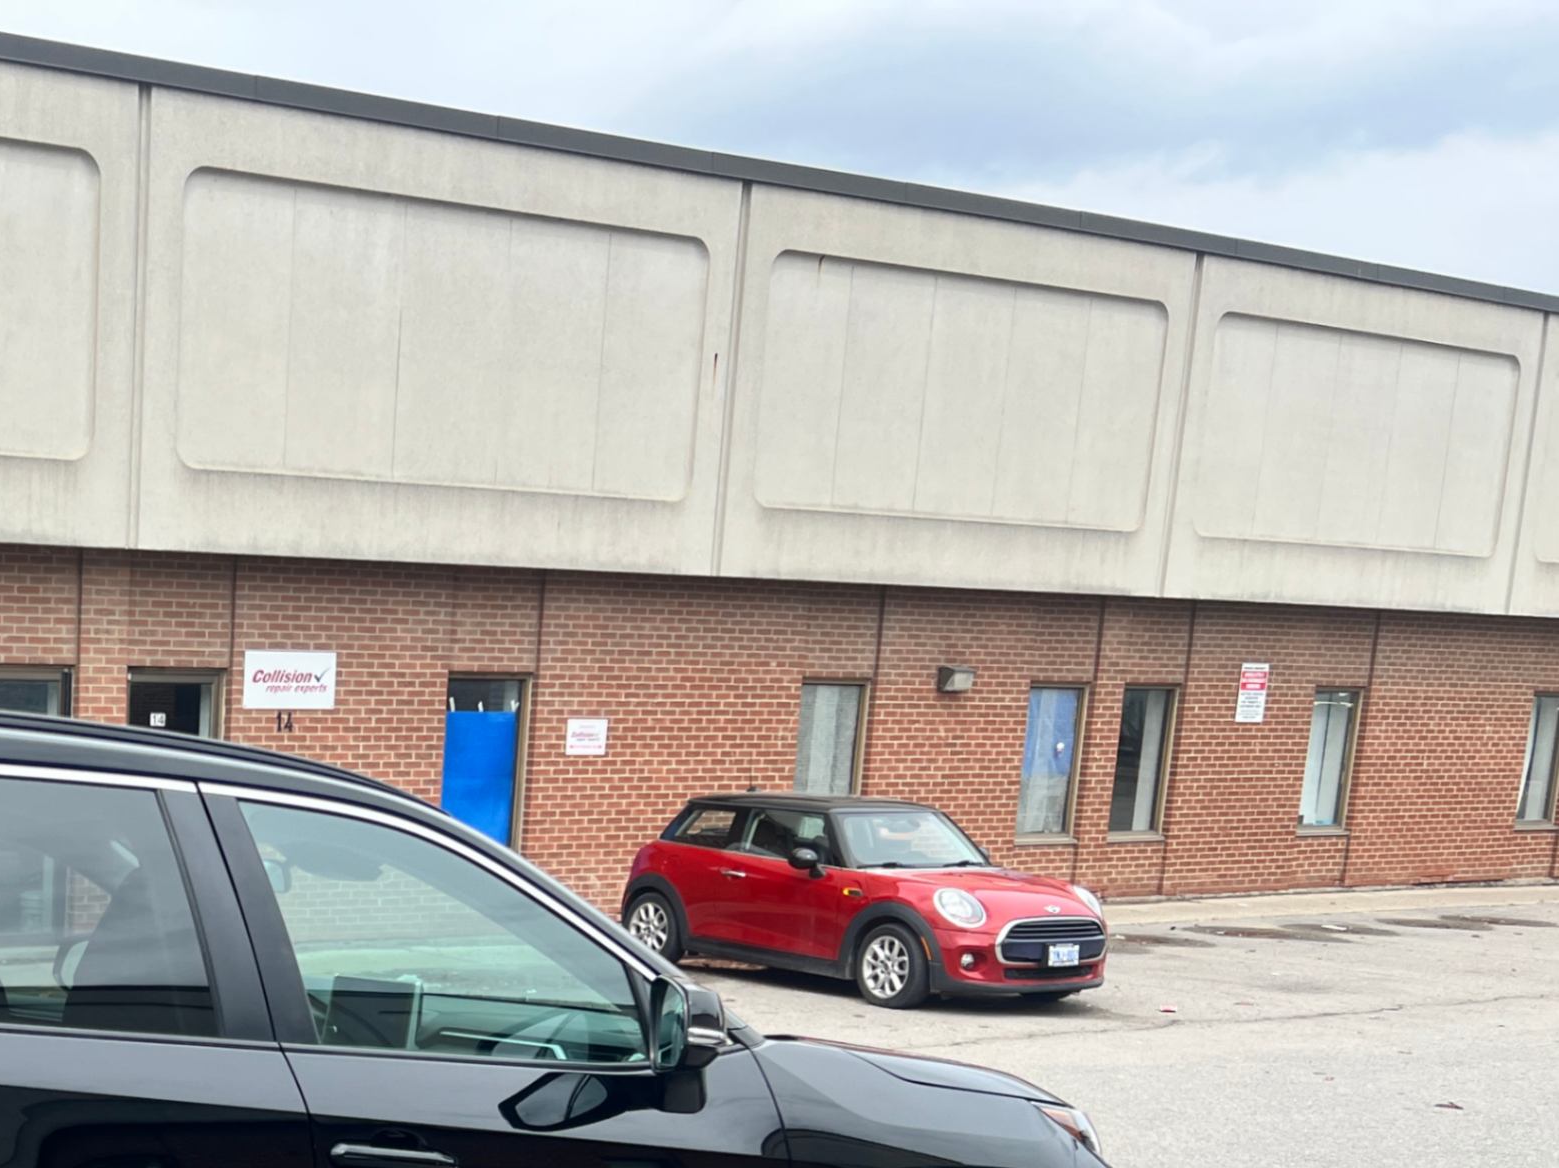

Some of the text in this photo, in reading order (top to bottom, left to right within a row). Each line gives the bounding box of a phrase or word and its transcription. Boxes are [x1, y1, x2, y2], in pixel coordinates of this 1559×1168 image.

[252, 669, 313, 684] Collision
[266, 684, 328, 694] repair experts
[276, 711, 294, 733] 14
